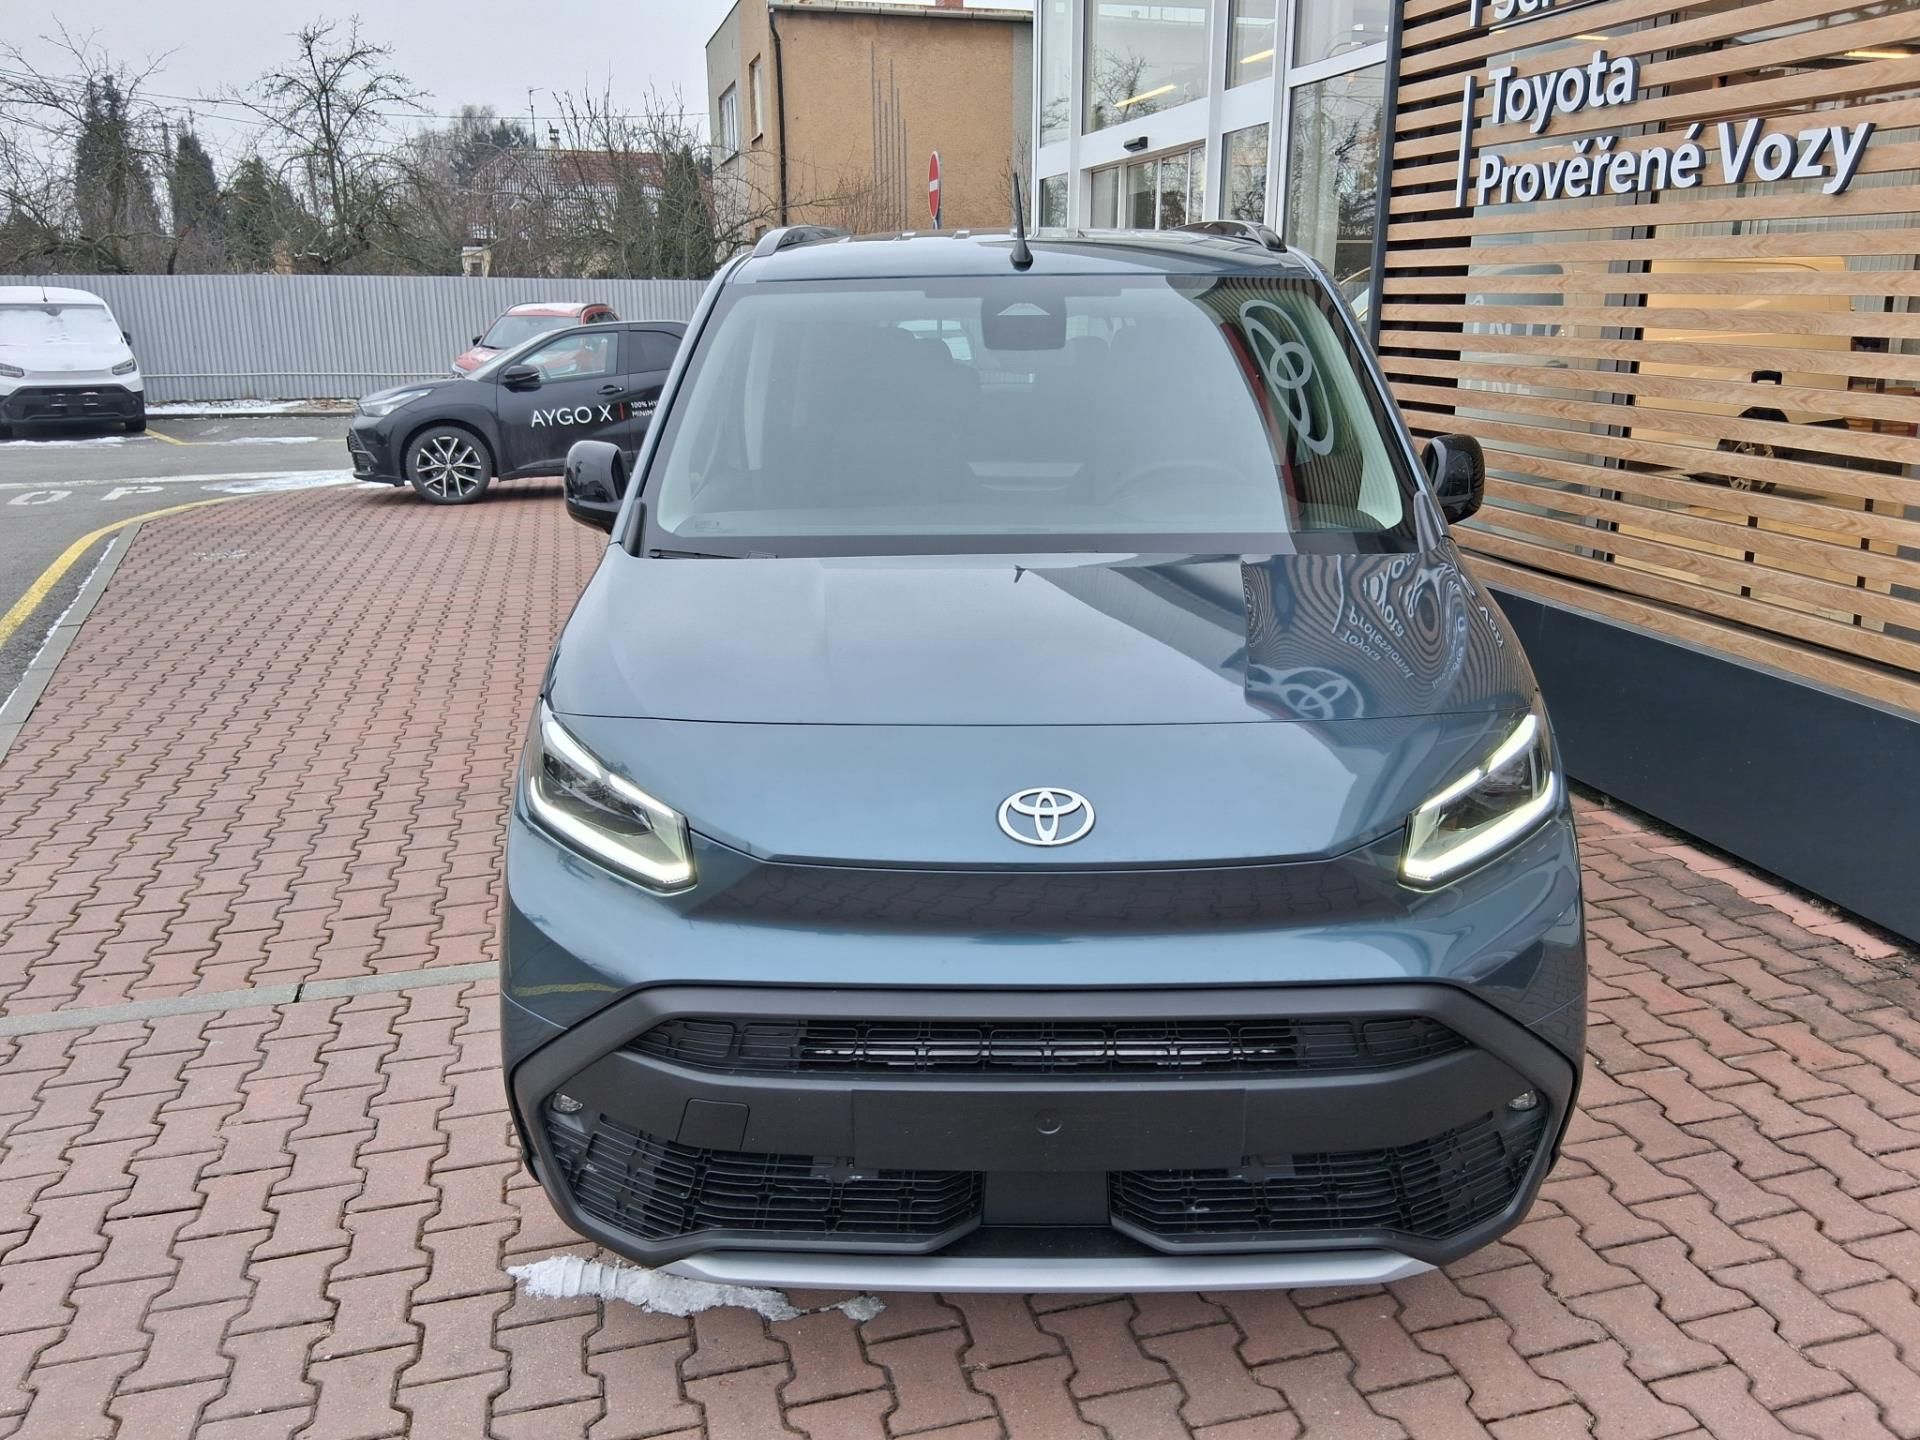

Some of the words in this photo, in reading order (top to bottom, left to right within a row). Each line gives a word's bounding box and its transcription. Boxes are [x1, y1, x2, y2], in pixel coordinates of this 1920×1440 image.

[1488, 50, 1638, 134] Toyota
[1478, 123, 1704, 205] Prověřené
[1718, 118, 1874, 195] Vozy
[531, 406, 592, 428] AYGO
[598, 404, 613, 422] X
[631, 401, 648, 409] 100%
[632, 409, 654, 418] MINIM
